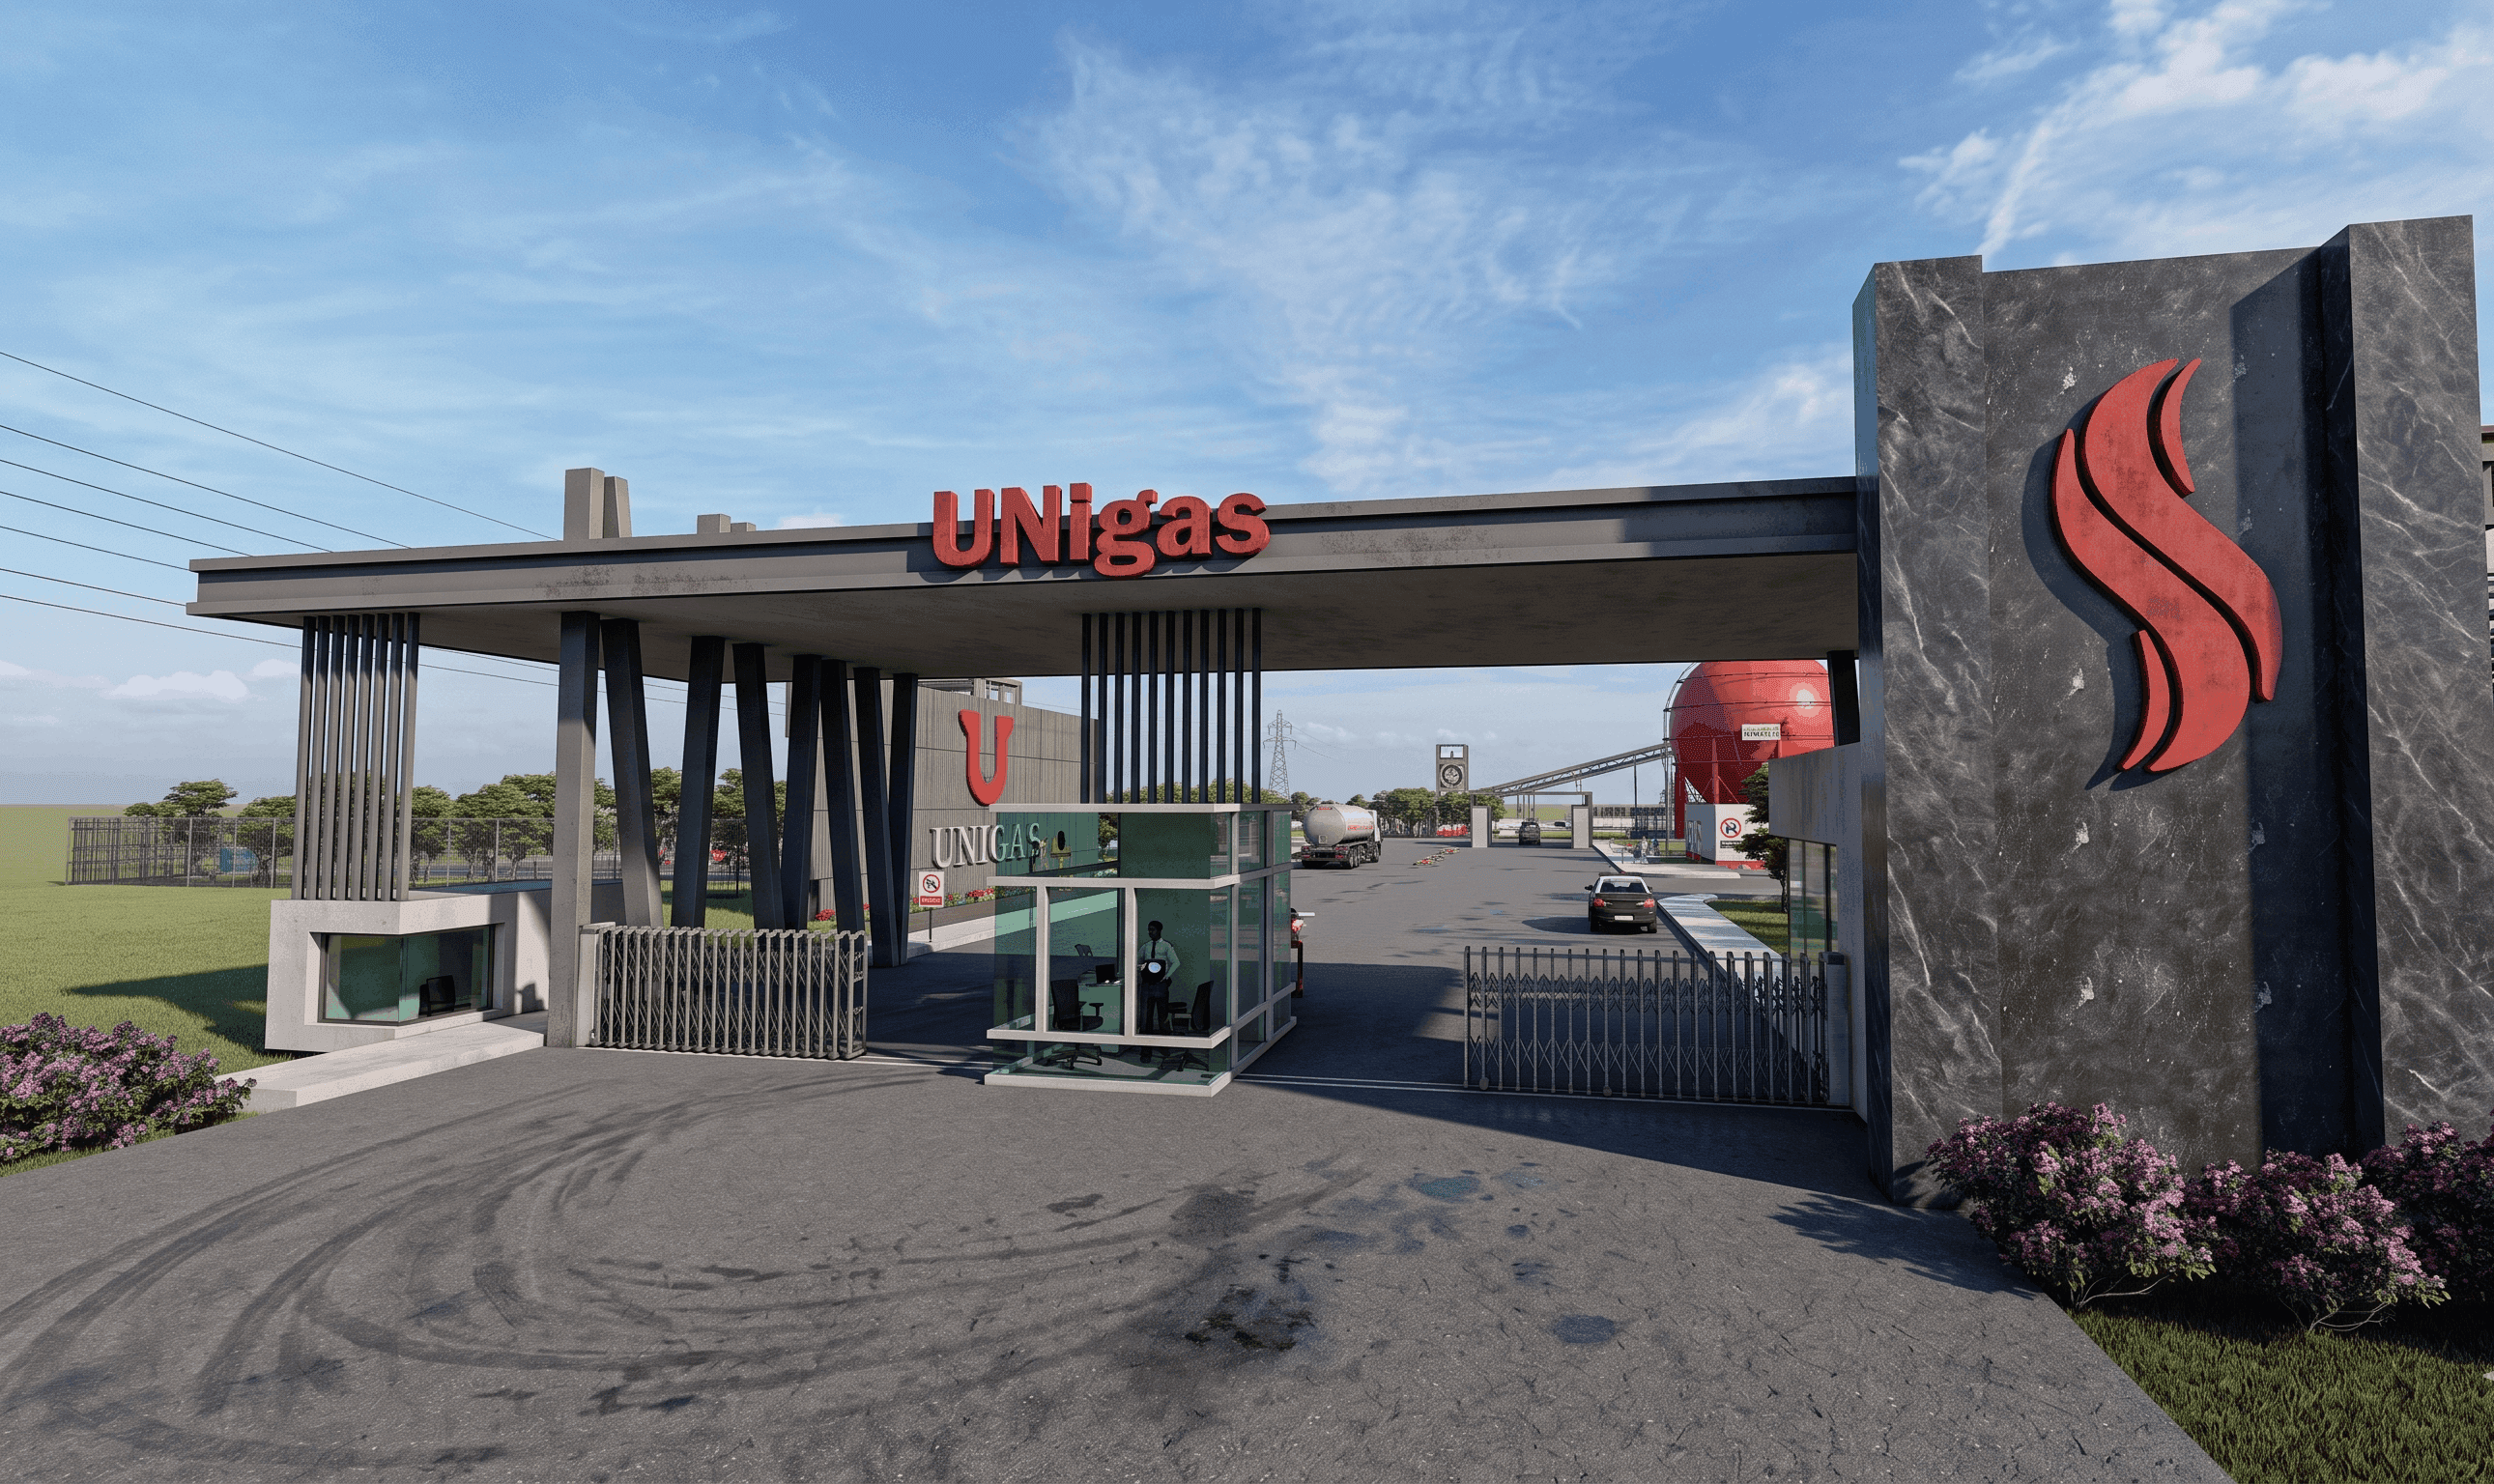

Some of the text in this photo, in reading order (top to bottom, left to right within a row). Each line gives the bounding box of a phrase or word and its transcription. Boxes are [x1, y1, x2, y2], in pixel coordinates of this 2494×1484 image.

[932, 483, 1271, 577] UNigas
[959, 709, 1015, 806] U
[931, 822, 1040, 869] UNIGAS
